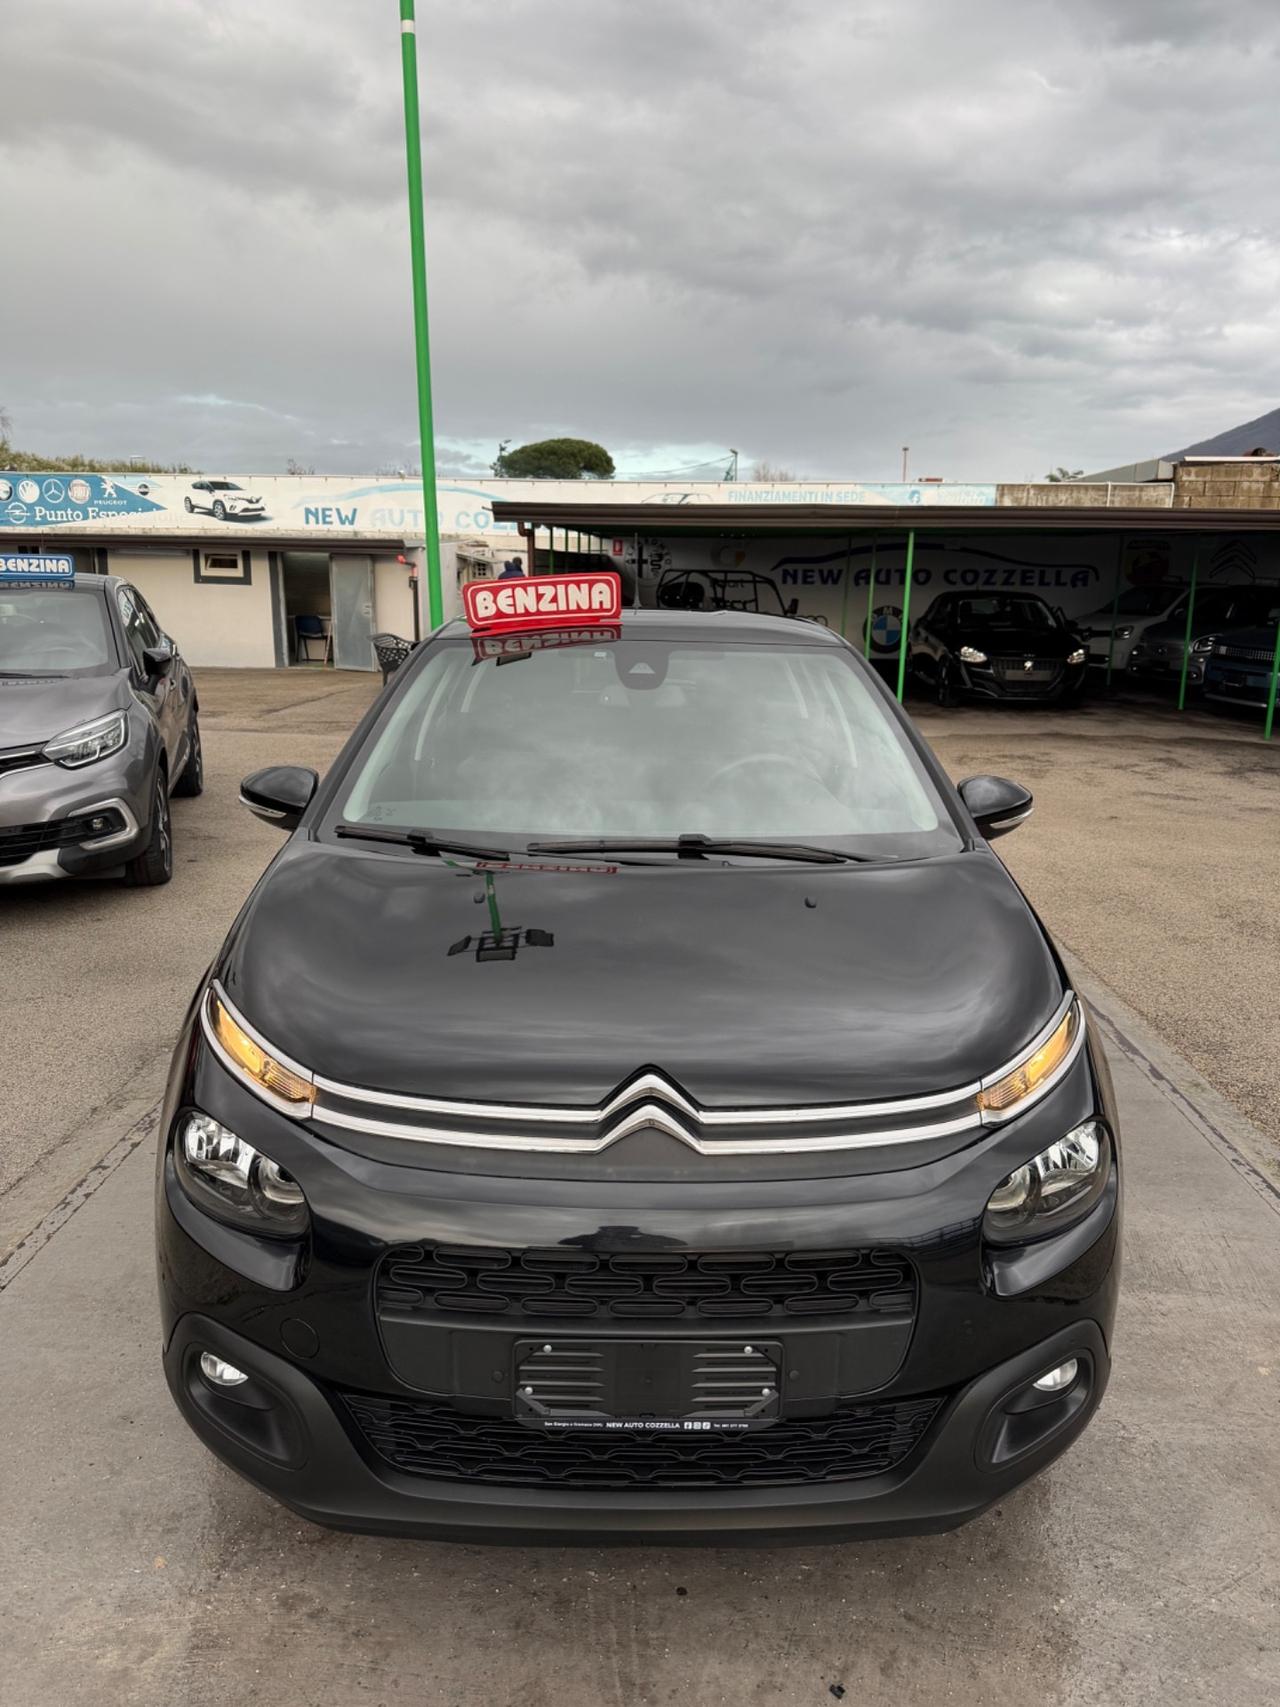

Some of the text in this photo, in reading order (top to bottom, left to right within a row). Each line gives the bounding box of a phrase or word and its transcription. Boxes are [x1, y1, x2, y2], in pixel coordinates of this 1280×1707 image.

[728, 490, 866, 502] FINANZIAMENTI IN SEDE
[34, 506, 83, 521] Punto
[304, 507, 357, 526] NEW
[782, 568, 1090, 588] NEW AUTO COZZELLA
[474, 582, 611, 618] BENZINA
